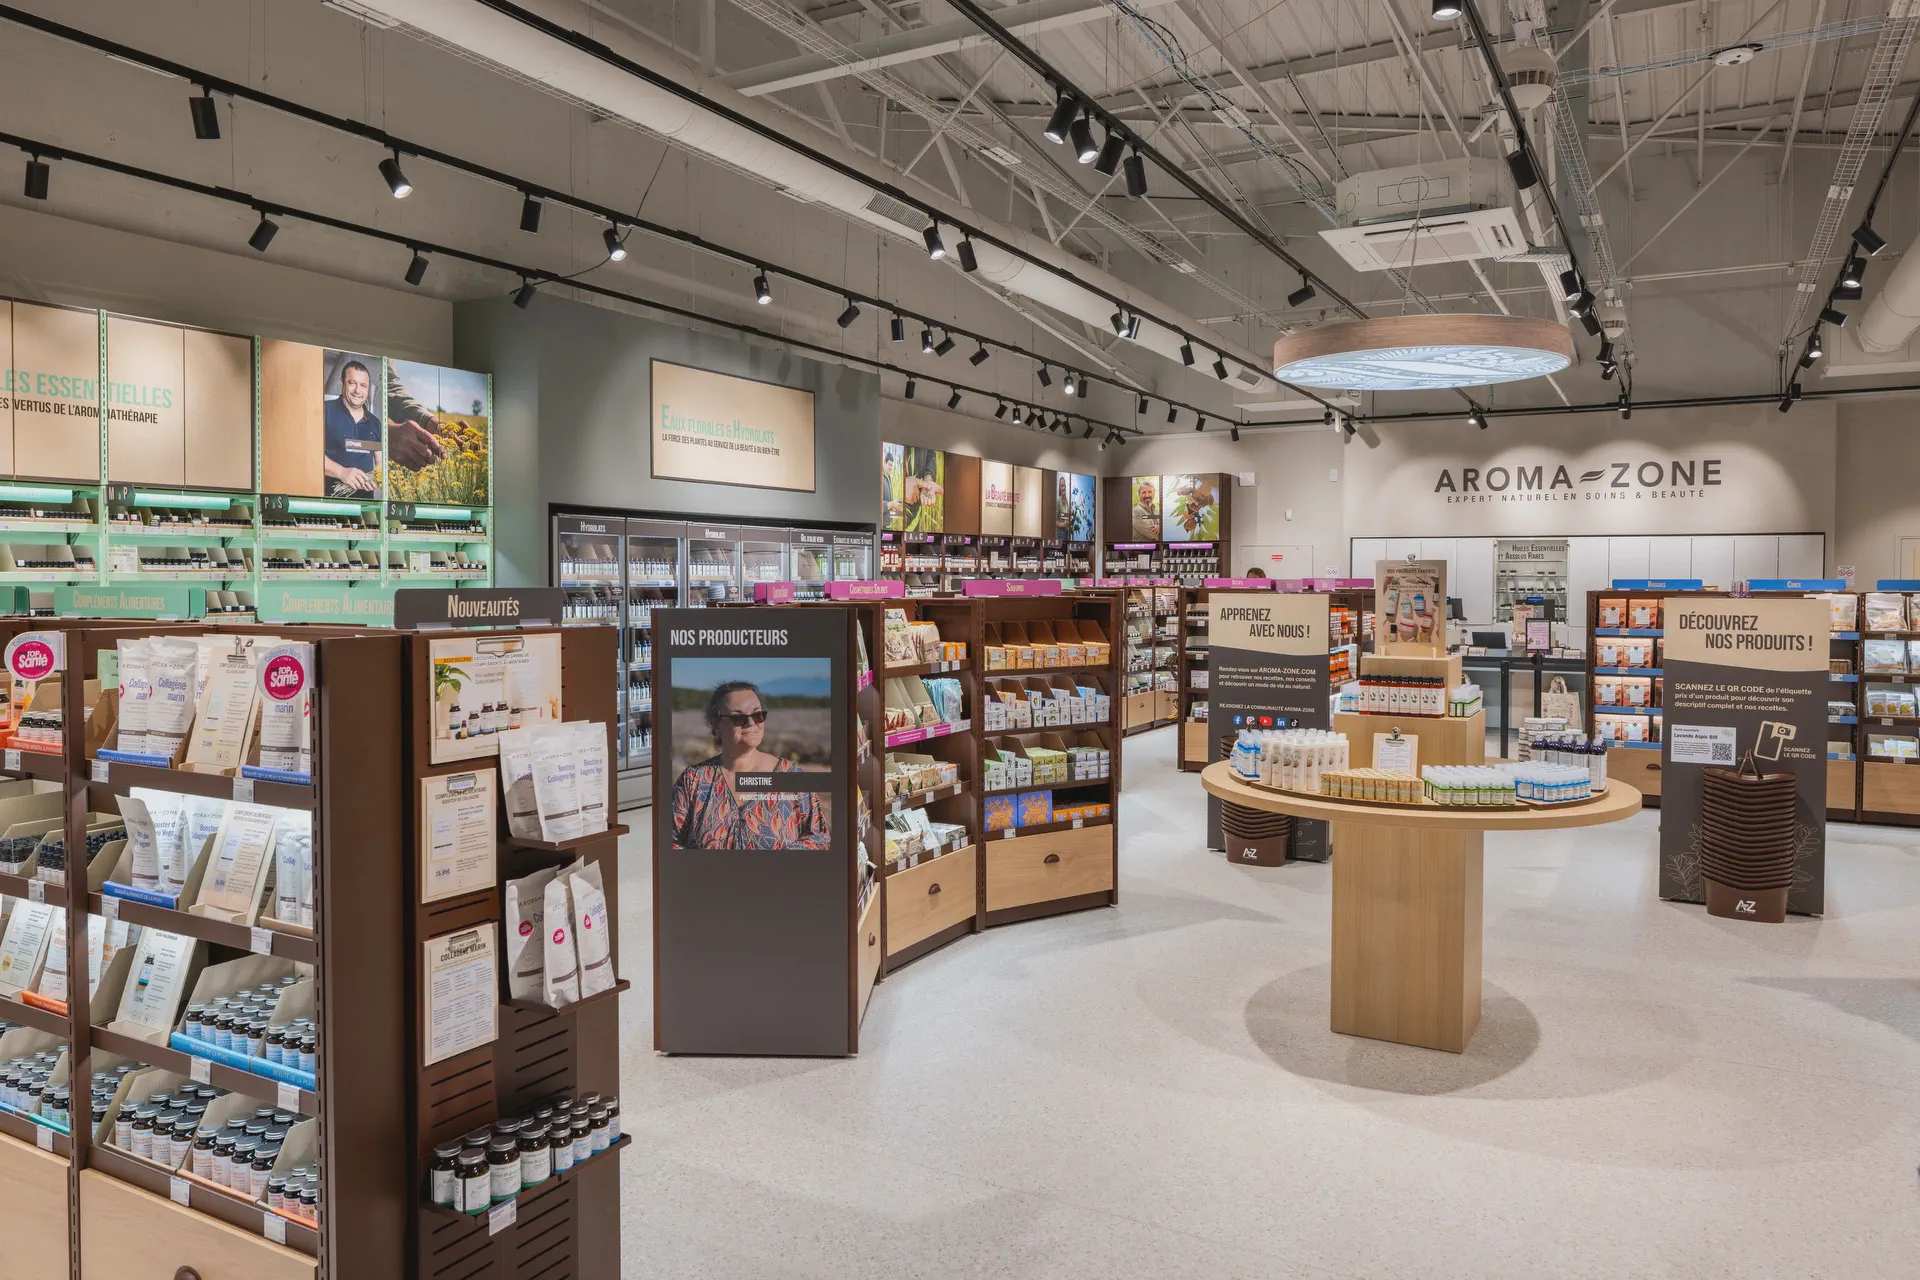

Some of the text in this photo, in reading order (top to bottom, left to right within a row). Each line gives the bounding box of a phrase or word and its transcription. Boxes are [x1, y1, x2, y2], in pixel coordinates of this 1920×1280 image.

[14, 399, 159, 425] VERTUS DE L'AROMATHÉRAPIE
[688, 418, 725, 437] FLORALES
[733, 419, 775, 445] HYDROLATS
[662, 433, 667, 441] LA
[668, 434, 681, 443] FORCE
[681, 435, 689, 444] DES
[690, 436, 707, 446] PLANTES
[707, 439, 713, 447] AU
[714, 440, 729, 449] SERVICE
[729, 442, 734, 450] DE
[734, 443, 740, 451] LA
[740, 443, 753, 452] BEAUTÉ
[757, 445, 762, 454] DU
[762, 446, 780, 456] BIEN-ÊTRE
[1434, 460, 1722, 493] AROMA ZONE
[109, 487, 128, 500] M P
[1447, 488, 1705, 503] EXPERT NATUREL EN SOINS & BEAUTÉ
[264, 499, 283, 509] P S
[391, 505, 410, 516] S Y
[1531, 543, 1565, 552] ESSENTIELLES
[1006, 582, 1024, 592] SAVONS
[73, 590, 165, 611] COMPLÉMENTS ALIMENTAIRES
[281, 592, 339, 614] COMPLÉMENTS
[447, 594, 520, 618] NOUVEAUTÉS
[1220, 607, 1271, 622] APPRENEZ
[1679, 611, 1759, 631] DÉCOUVREZ
[670, 629, 788, 646] NOS PRODUCTEURS
[1249, 624, 1310, 638] AVEC NOUS !
[1705, 633, 1813, 651] NOS PRODUITS !
[27, 650, 40, 658] TOP
[18, 653, 48, 669] Santé
[278, 666, 291, 675] TOP
[1258, 667, 1316, 675] AROMA-ZONE.COM
[158, 677, 187, 691] Collagène
[269, 670, 299, 688] Santé
[1675, 683, 1714, 691] SCANNEZ
[1715, 684, 1725, 692] LE
[1727, 685, 1739, 693] QR
[1741, 685, 1764, 693] CODE
[1775, 687, 1812, 696] l'étiquette
[167, 692, 185, 702] marin
[1675, 693, 1687, 701] prix
[1705, 694, 1729, 702] produit
[1748, 695, 1780, 703] découvrir
[275, 703, 294, 714] marin
[1250, 704, 1283, 712] COMMUNAUTÉ
[1675, 701, 1706, 709] descriptif
[1707, 702, 1734, 711] complet
[739, 776, 773, 786] CHRISTINE
[200, 824, 219, 832] Booster
